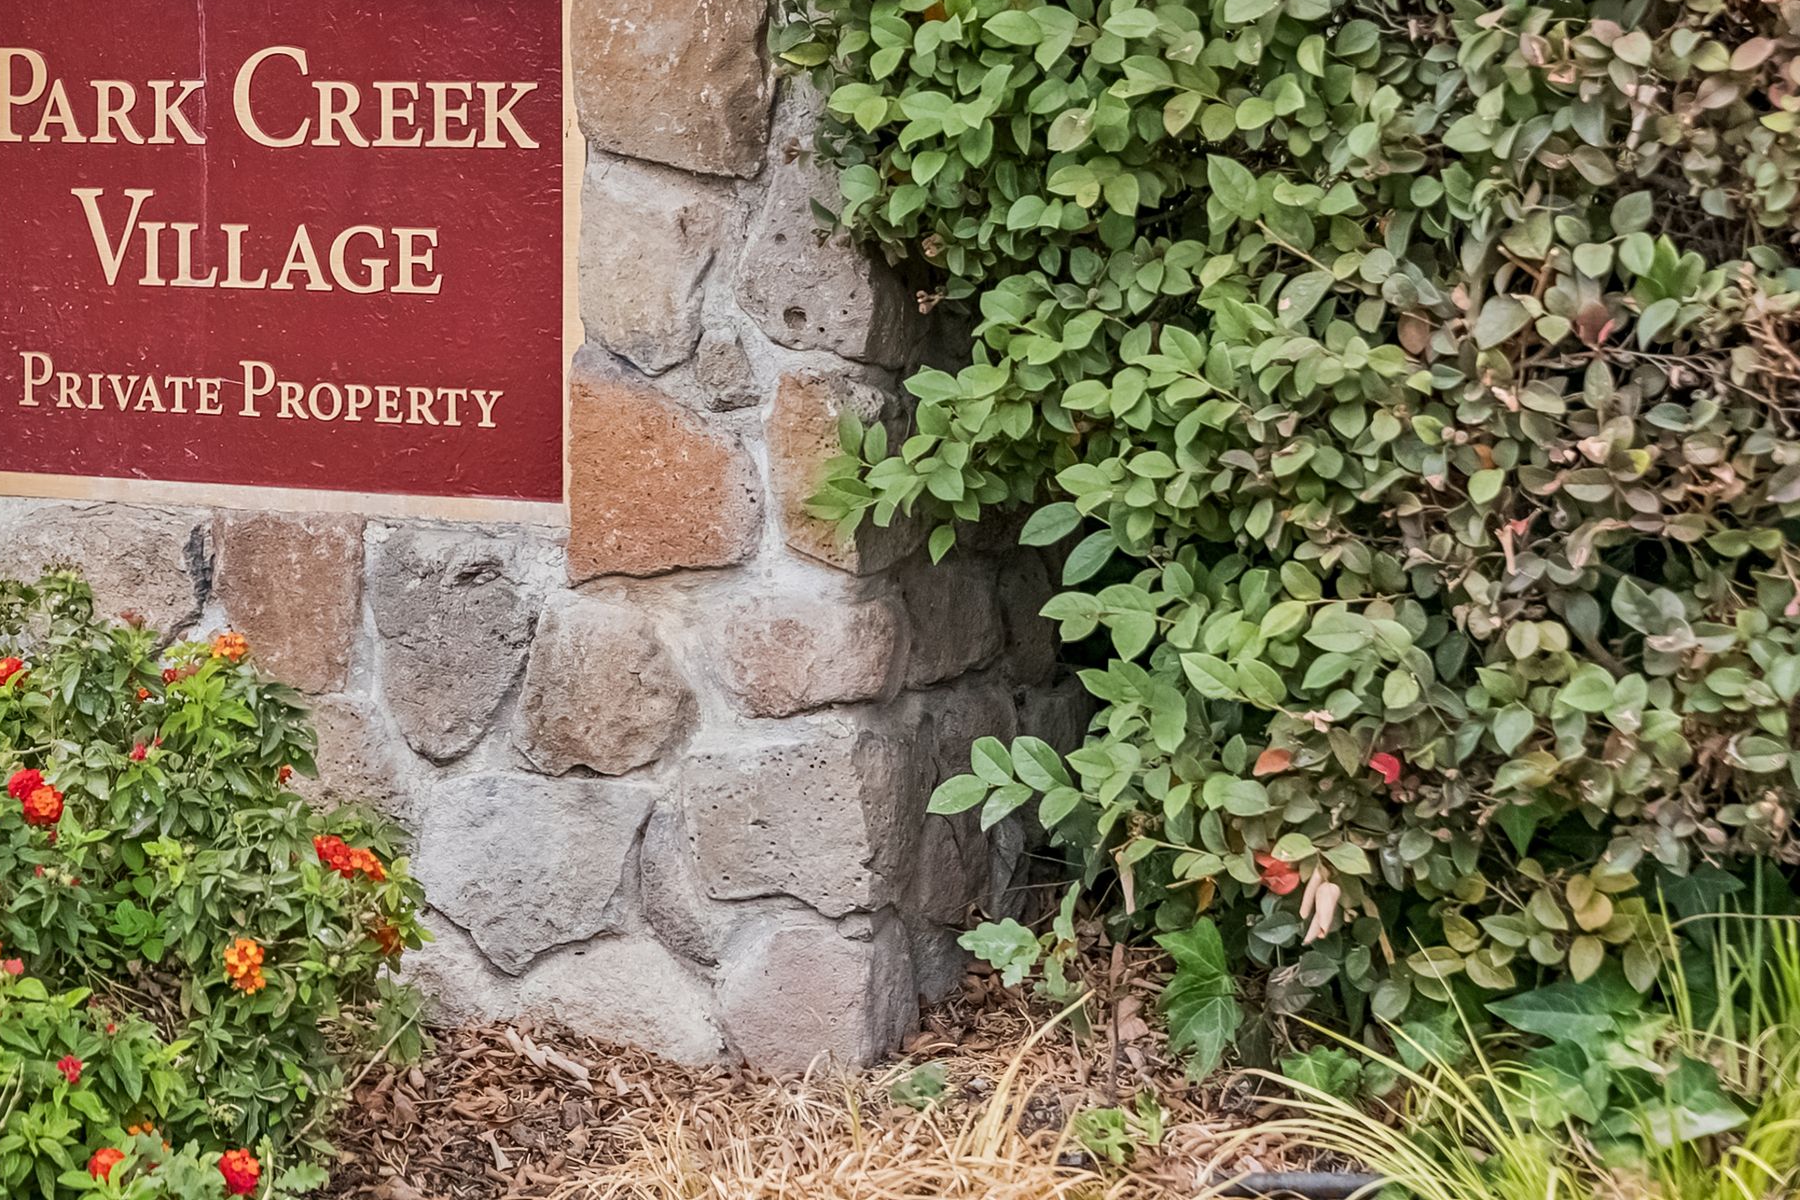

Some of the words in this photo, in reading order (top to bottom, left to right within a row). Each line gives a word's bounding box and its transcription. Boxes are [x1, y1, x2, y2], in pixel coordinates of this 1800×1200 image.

[233, 45, 540, 149] CREEK
[70, 187, 443, 294] VILLAGE
[18, 351, 225, 417] PRIVATE
[238, 360, 504, 429] PROPERTY
